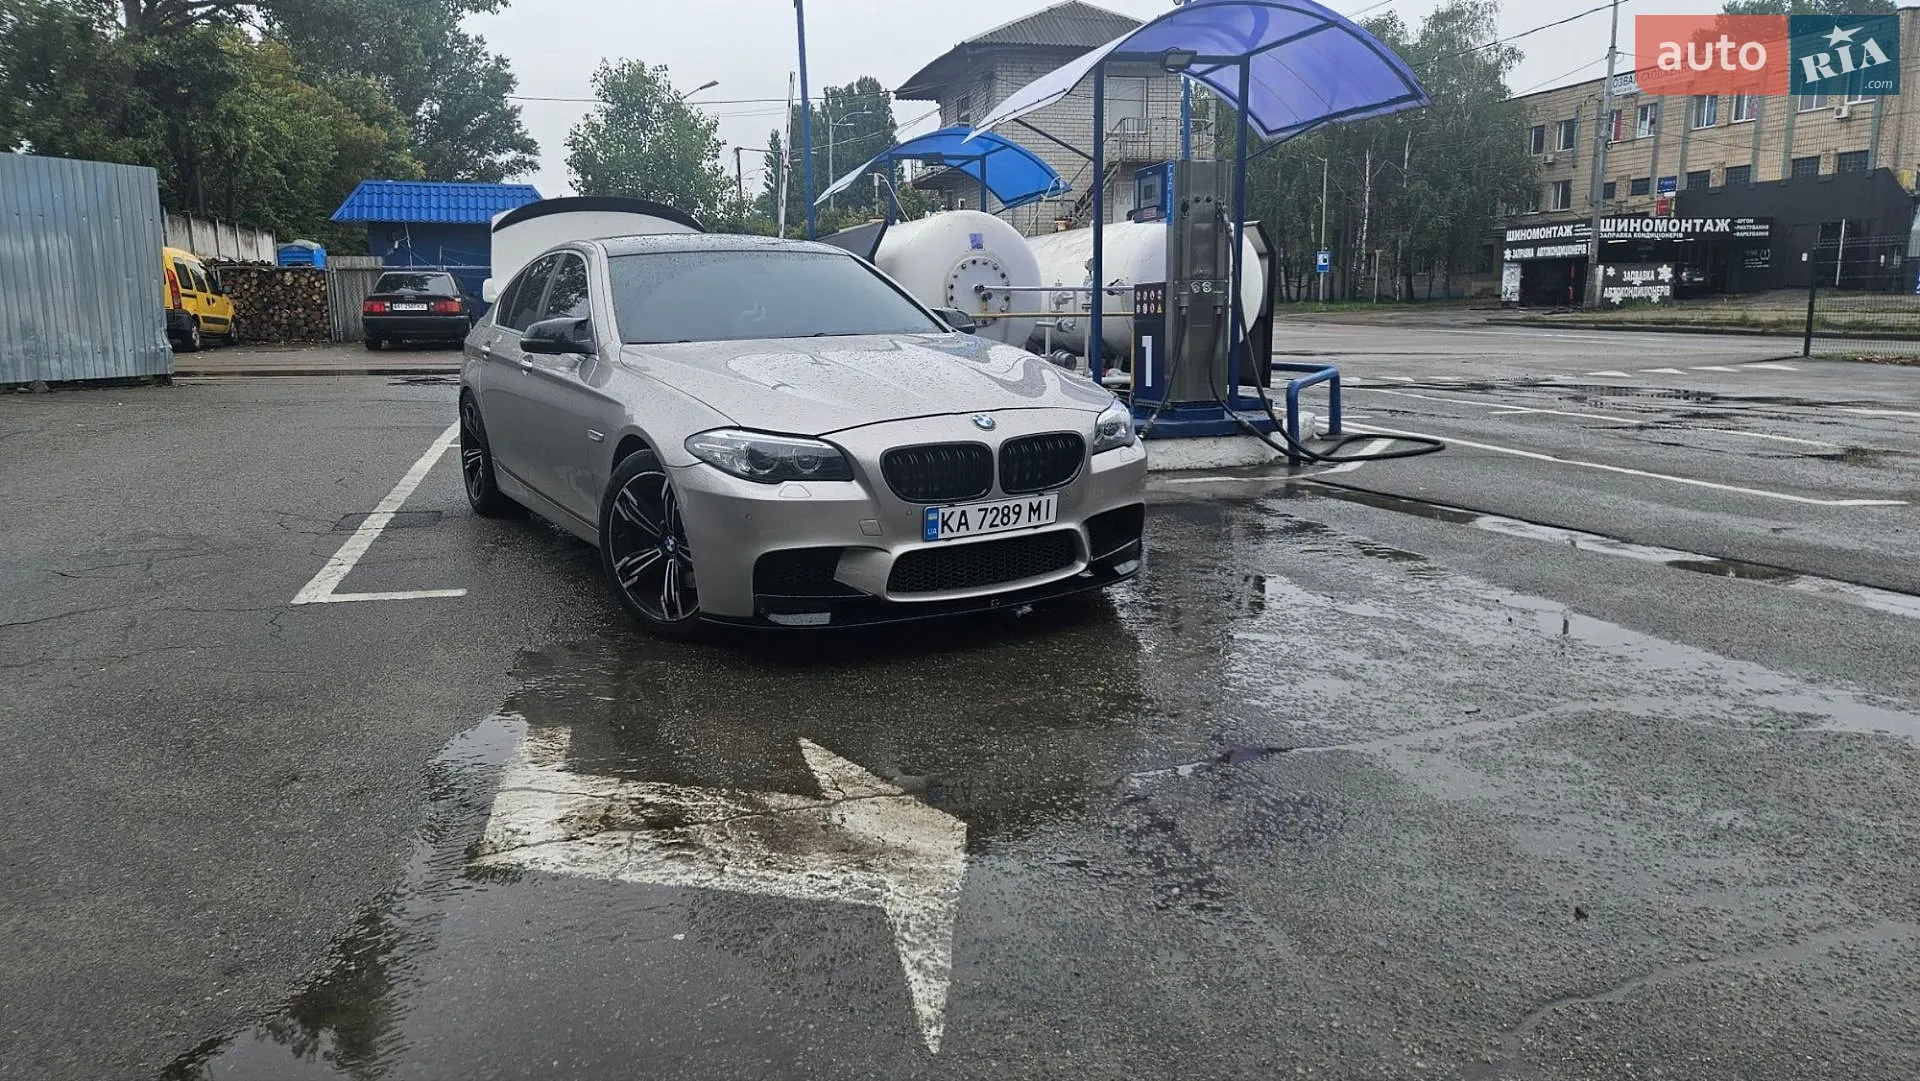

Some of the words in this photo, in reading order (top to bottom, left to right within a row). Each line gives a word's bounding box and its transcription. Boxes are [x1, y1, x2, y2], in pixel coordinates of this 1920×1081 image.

[1506, 225, 1574, 242] ШИНОМОНТАЖ
[1600, 218, 1730, 233] ШИНОМОНТАЖ
[1141, 335, 1153, 387] 1
[940, 510, 970, 534] KA
[977, 504, 1022, 530] 7289
[1027, 499, 1051, 522] MI
[927, 527, 938, 535] UA
